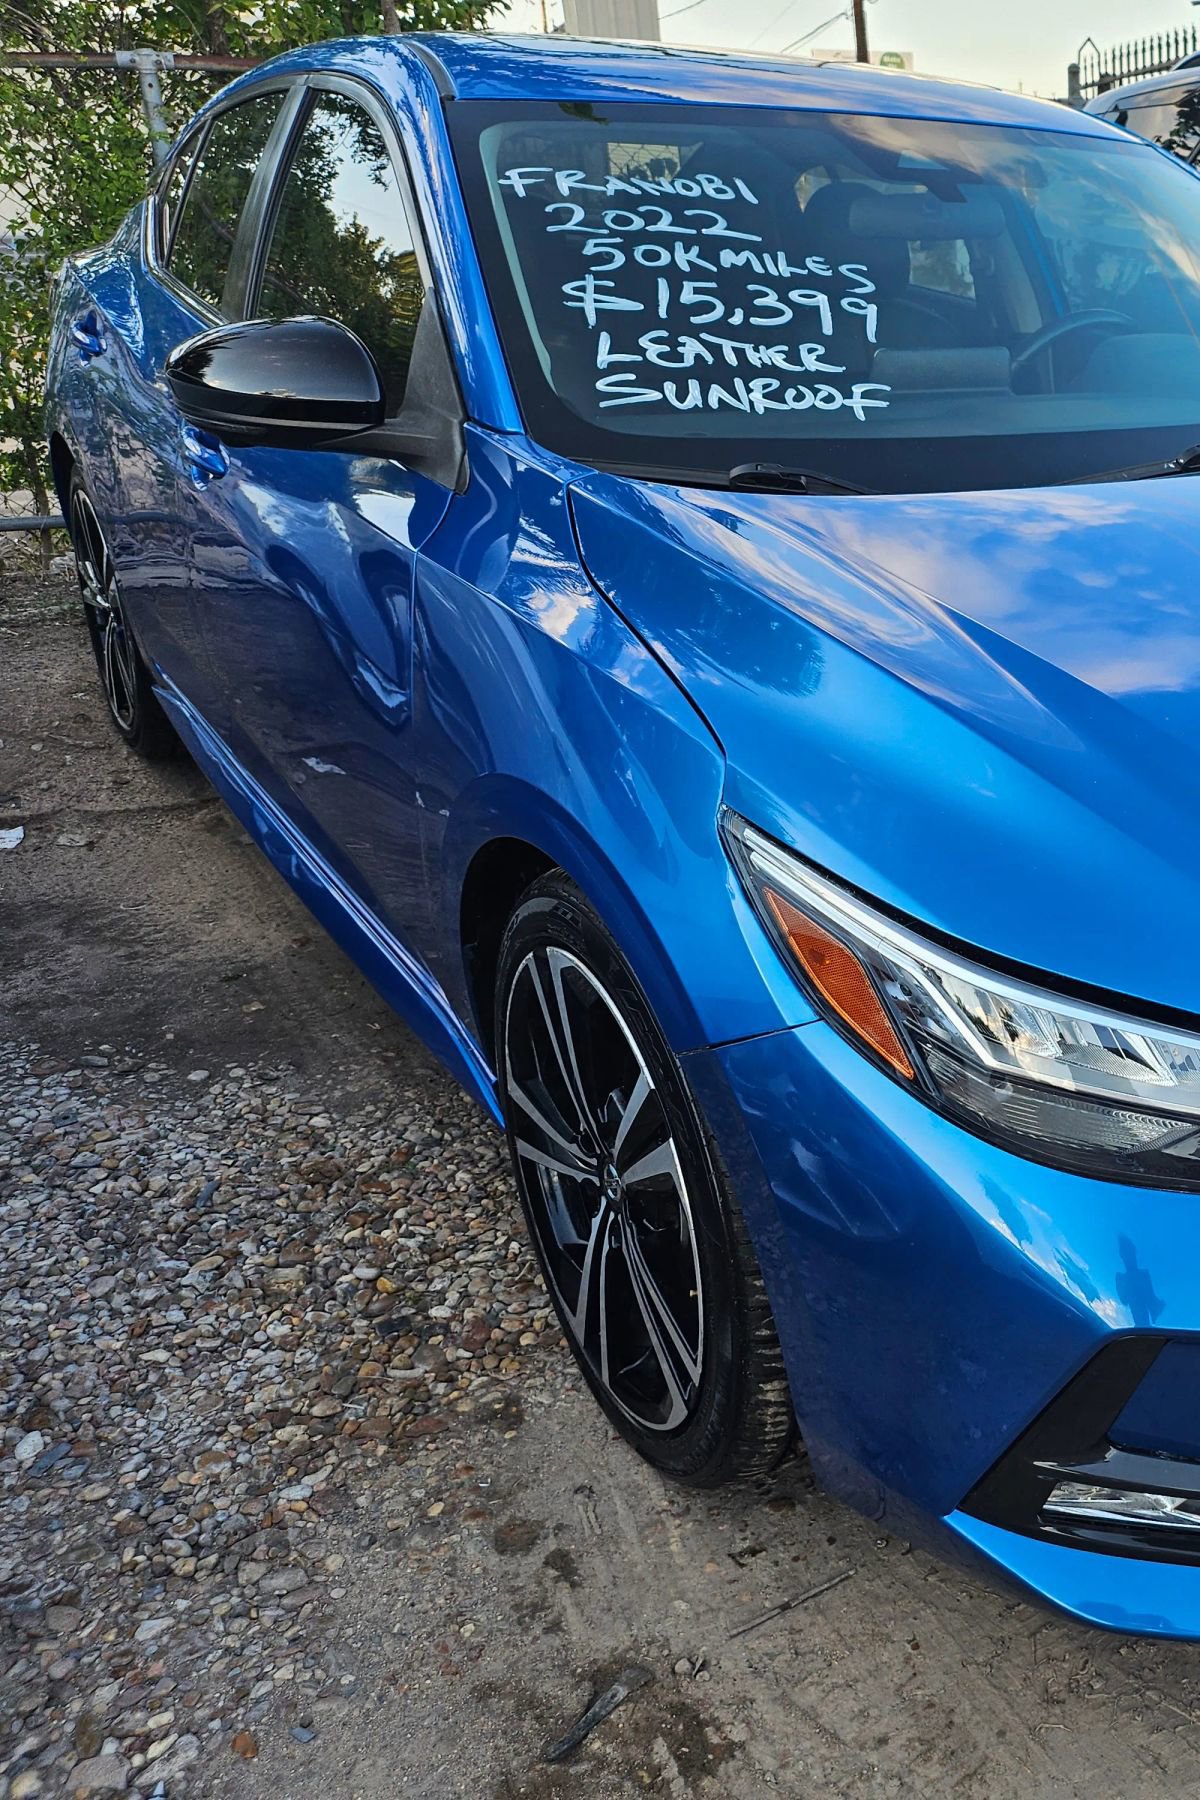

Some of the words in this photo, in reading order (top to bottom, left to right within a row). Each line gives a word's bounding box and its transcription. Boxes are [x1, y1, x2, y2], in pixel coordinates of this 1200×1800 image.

[498, 167, 758, 204] FRANOBI
[545, 203, 762, 241] 2022
[562, 274, 878, 343] $15,399
[599, 329, 847, 373] LEATHER
[595, 374, 892, 421] SUNROOF
